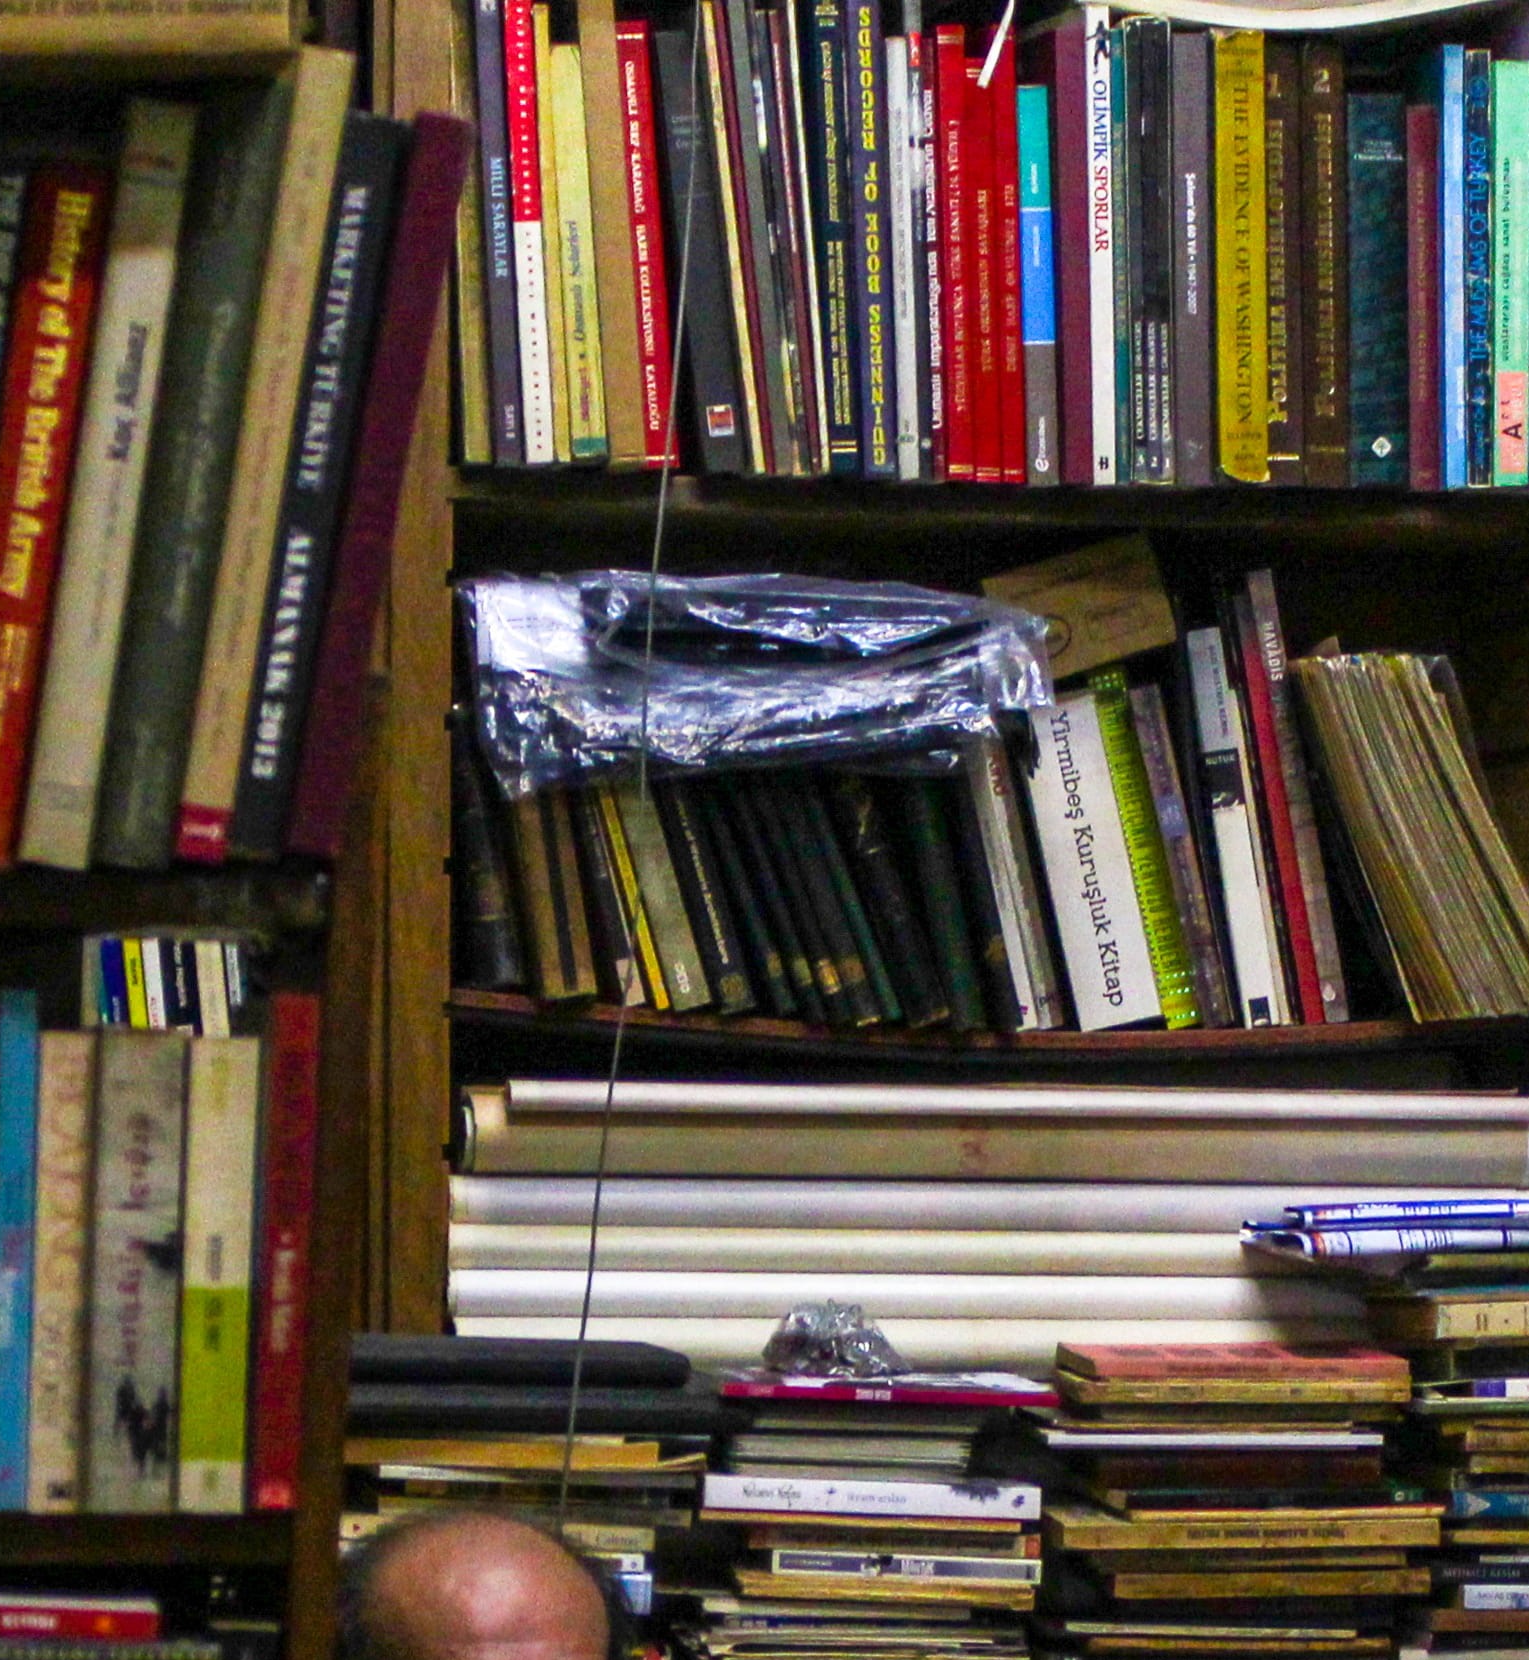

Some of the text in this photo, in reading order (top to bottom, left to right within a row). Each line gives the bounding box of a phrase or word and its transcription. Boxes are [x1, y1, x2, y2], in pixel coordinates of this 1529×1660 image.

[1312, 68, 1330, 93] 2
[1091, 81, 1110, 252] OLİMPİK SPORLAR
[1468, 131, 1488, 201] TURKEY
[43, 191, 93, 300] History
[490, 203, 509, 278] SARAYLAR
[858, 6, 886, 465] GUINNESS BOOK OF RECORDS
[1233, 86, 1254, 424] THE EVIDENCE OF WASHINGTON
[1468, 206, 1488, 235] OF
[317, 183, 367, 355] MARKETING
[28, 345, 68, 400] The
[1468, 324, 1488, 362] THE
[645, 365, 661, 430] KATALOĞU
[17, 407, 60, 510] British
[263, 528, 313, 697] ALMANAK
[250, 703, 285, 778] 2013
[1050, 712, 1126, 1008] Yirmibeş Kuruşluk Kitap
